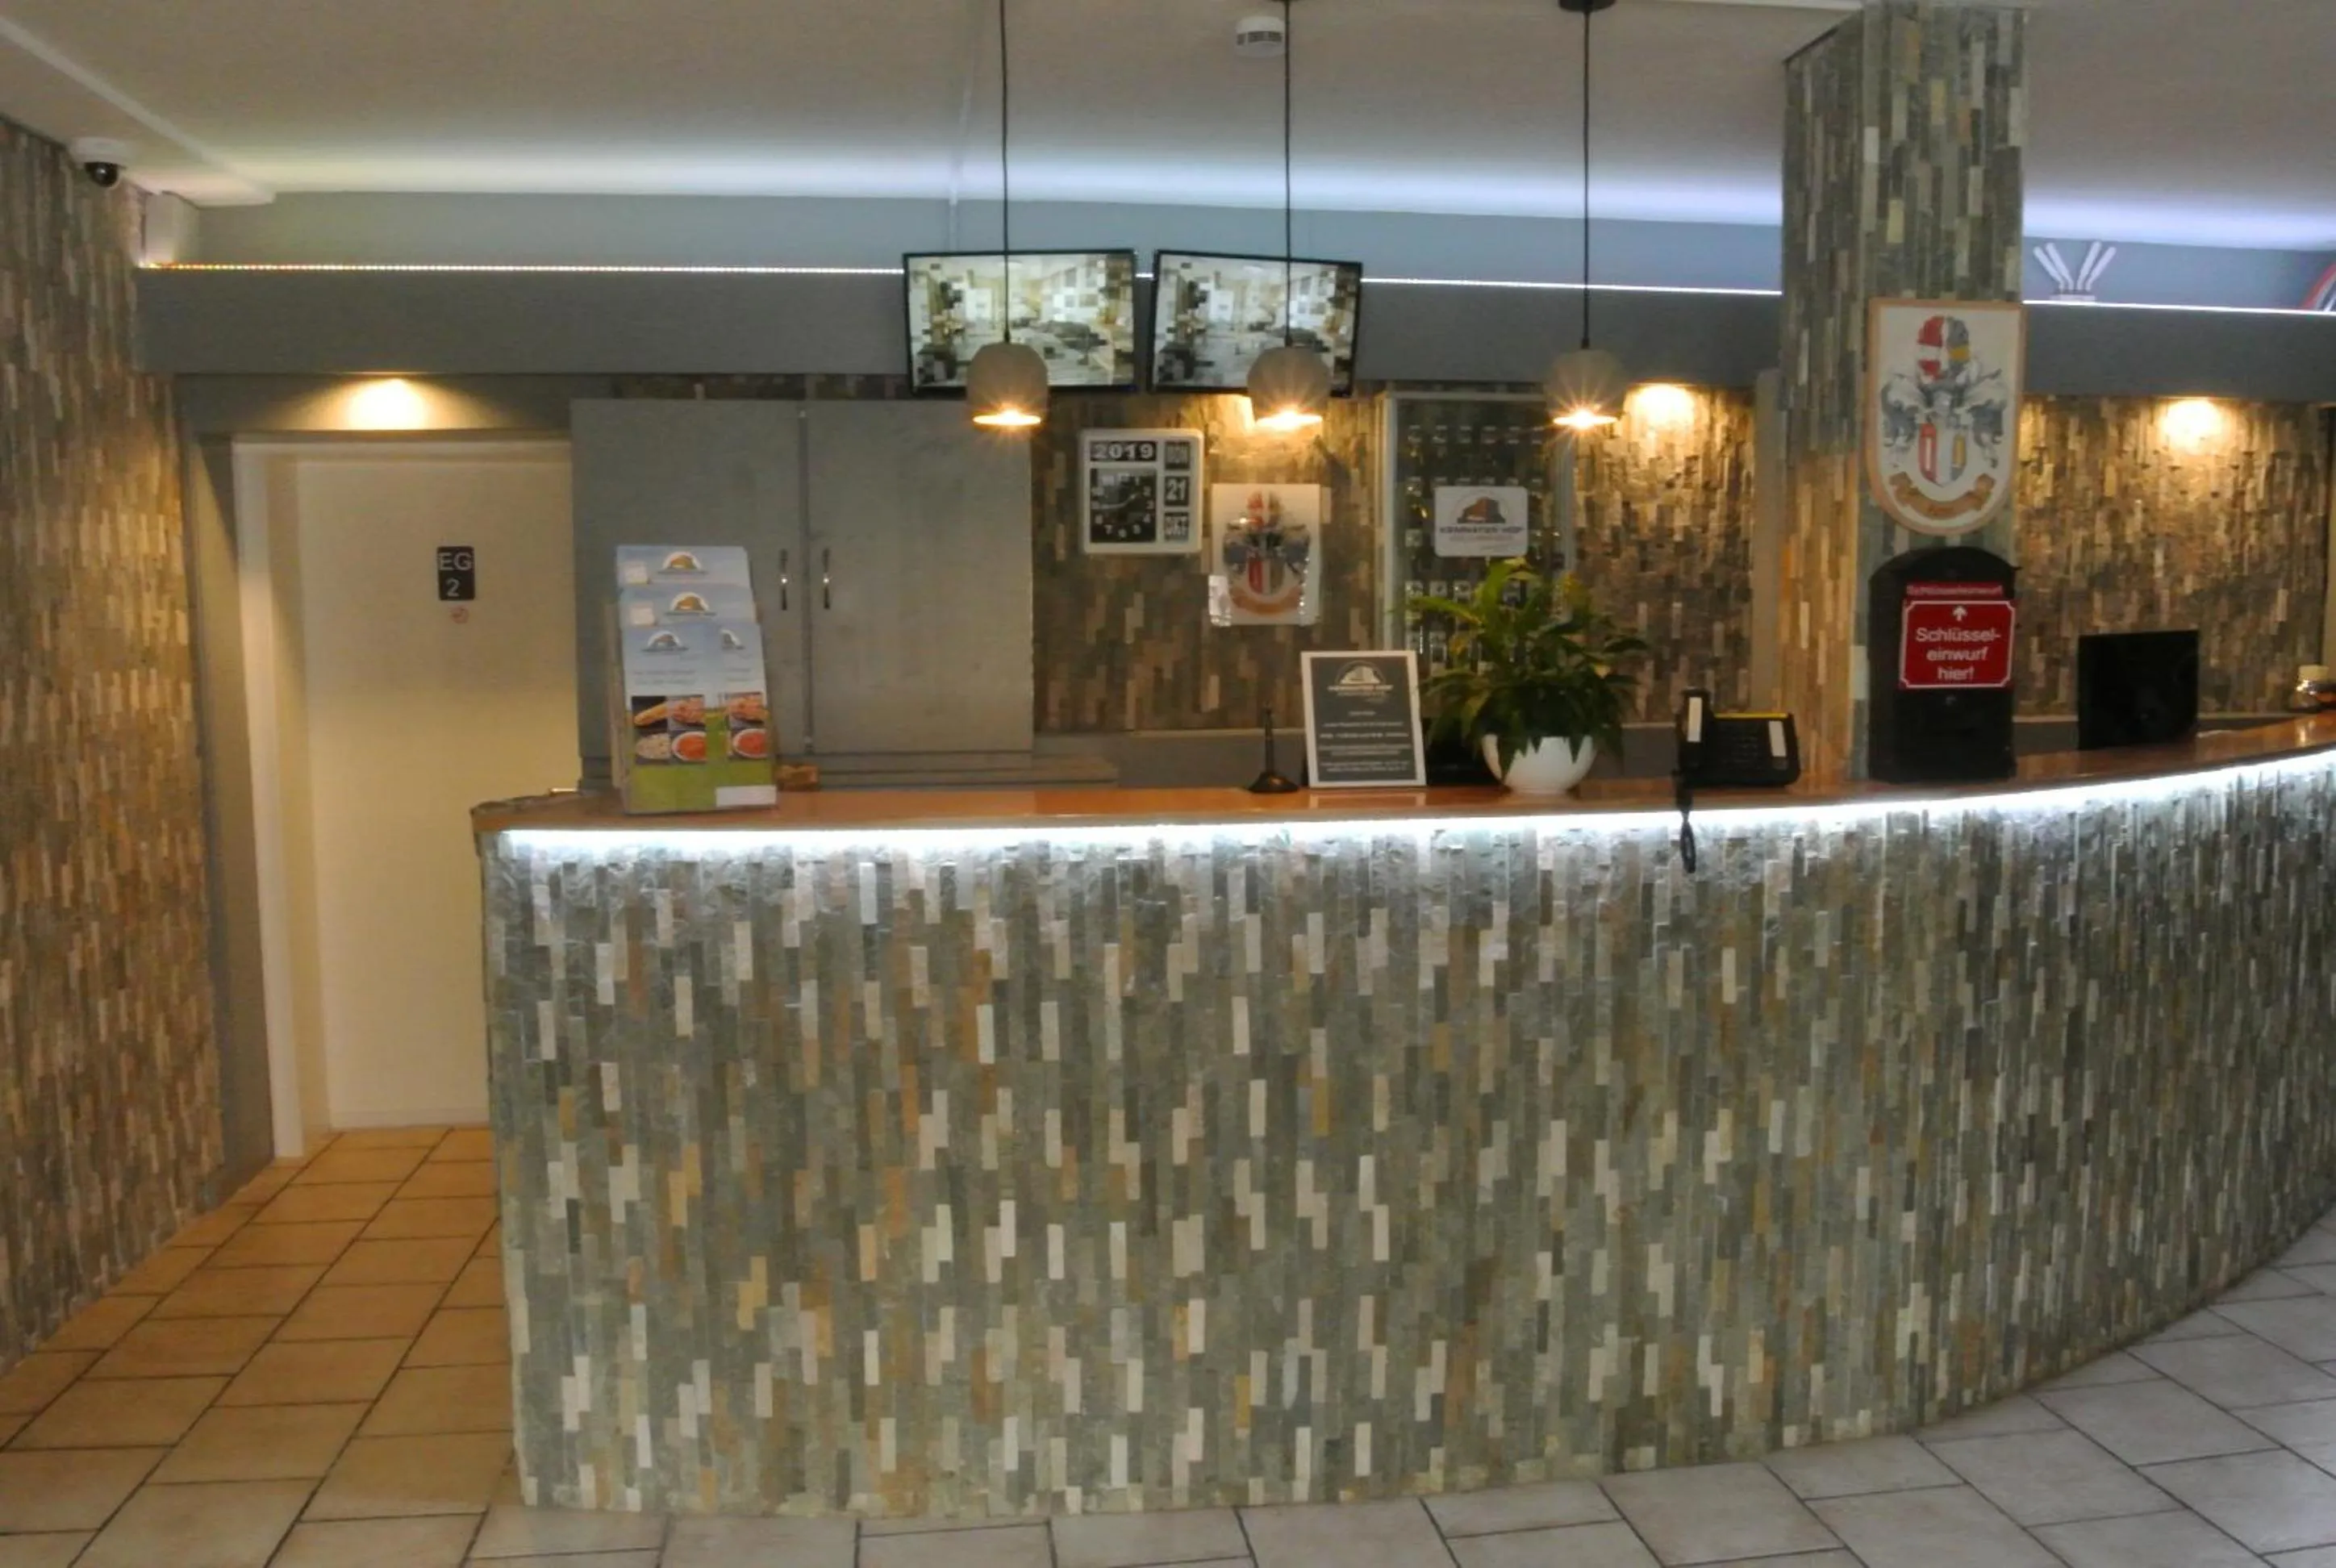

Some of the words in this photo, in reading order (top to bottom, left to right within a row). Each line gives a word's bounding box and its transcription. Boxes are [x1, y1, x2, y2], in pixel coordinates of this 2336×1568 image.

[1094, 444, 1153, 459] 2019
[1166, 477, 1187, 501] 21
[438, 552, 473, 571] EG
[446, 577, 460, 597] 2
[1916, 627, 2001, 643] Schlüssel-
[1926, 646, 1989, 661] einwurf
[1937, 665, 1975, 681] hier!
